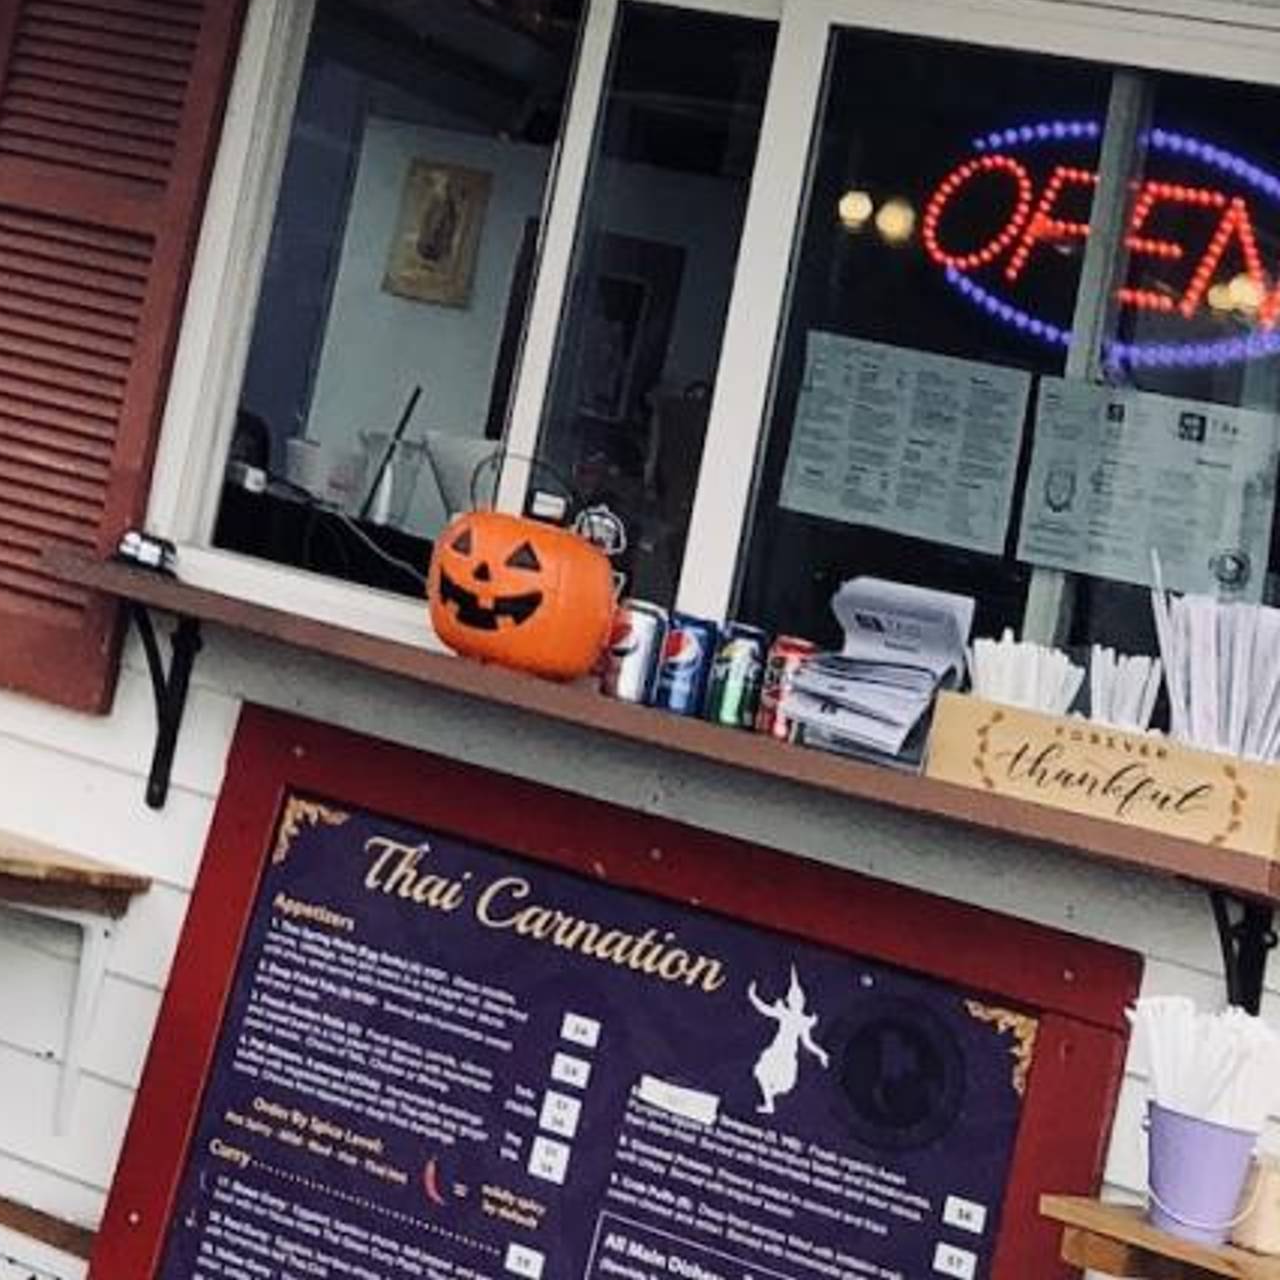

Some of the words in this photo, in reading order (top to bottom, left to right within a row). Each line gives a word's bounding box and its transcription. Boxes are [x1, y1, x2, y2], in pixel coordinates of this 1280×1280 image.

[994, 740, 1215, 818] thankful
[272, 893, 356, 932] Appetizers
[364, 836, 472, 910] Thai
[476, 877, 727, 992] Carnation
[209, 1138, 252, 1169] Curry
